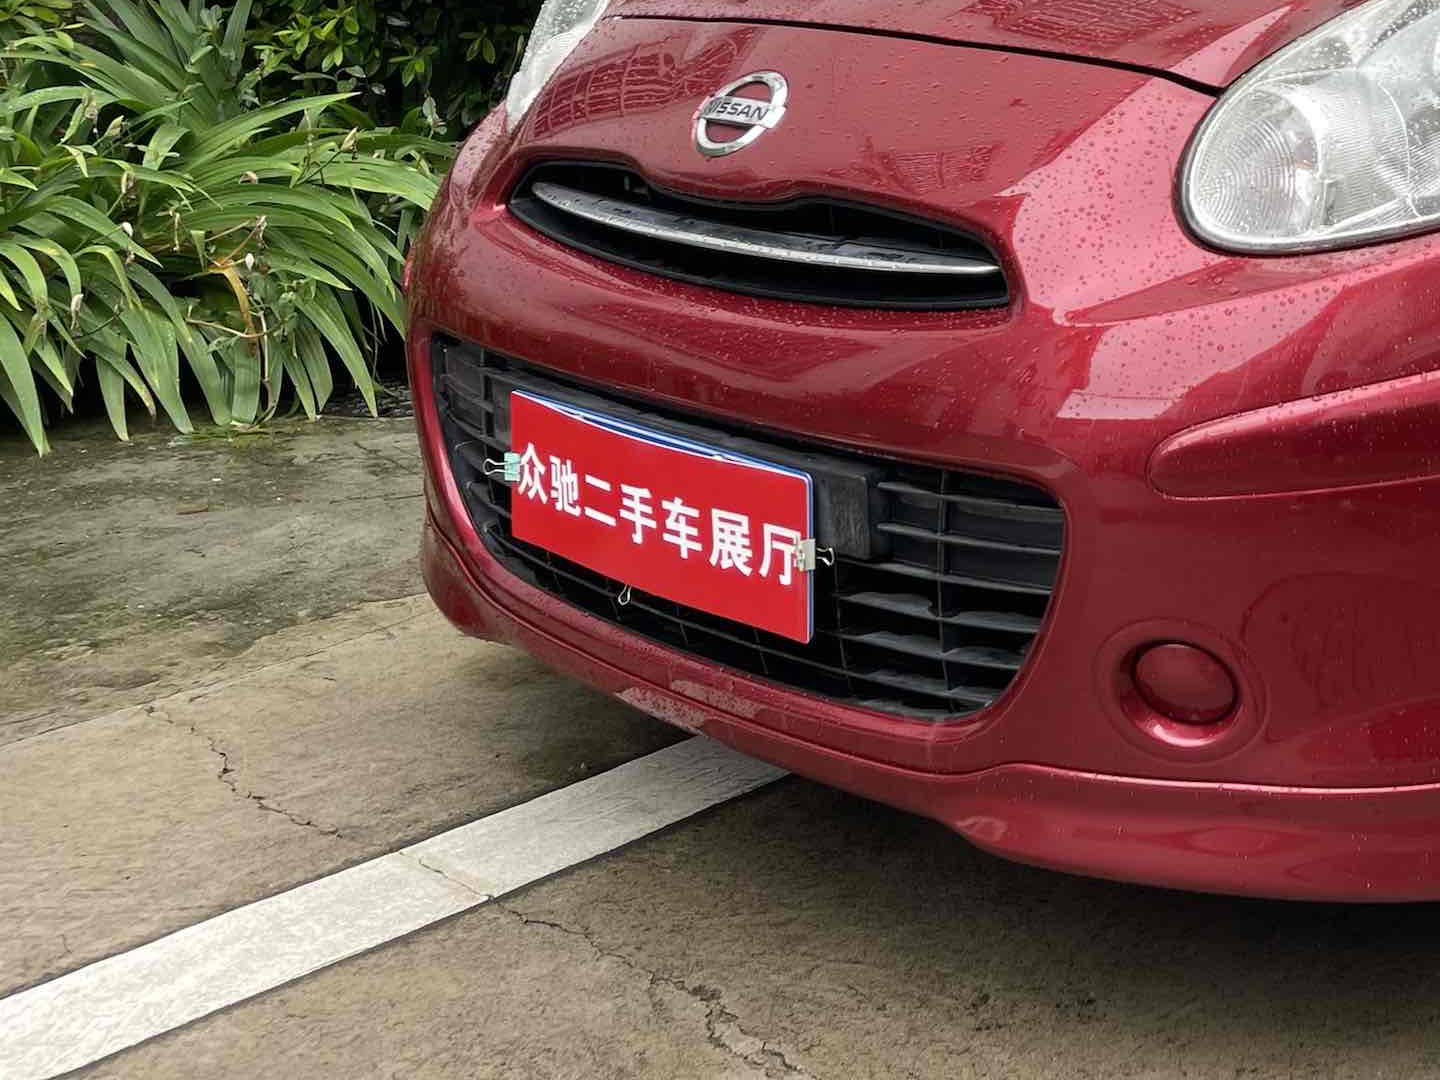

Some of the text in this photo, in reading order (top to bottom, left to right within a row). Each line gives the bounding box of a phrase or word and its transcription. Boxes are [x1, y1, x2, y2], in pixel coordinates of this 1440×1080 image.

[704, 100, 770, 121] NISSAN
[517, 442, 801, 586] 众驰二手车展厅
